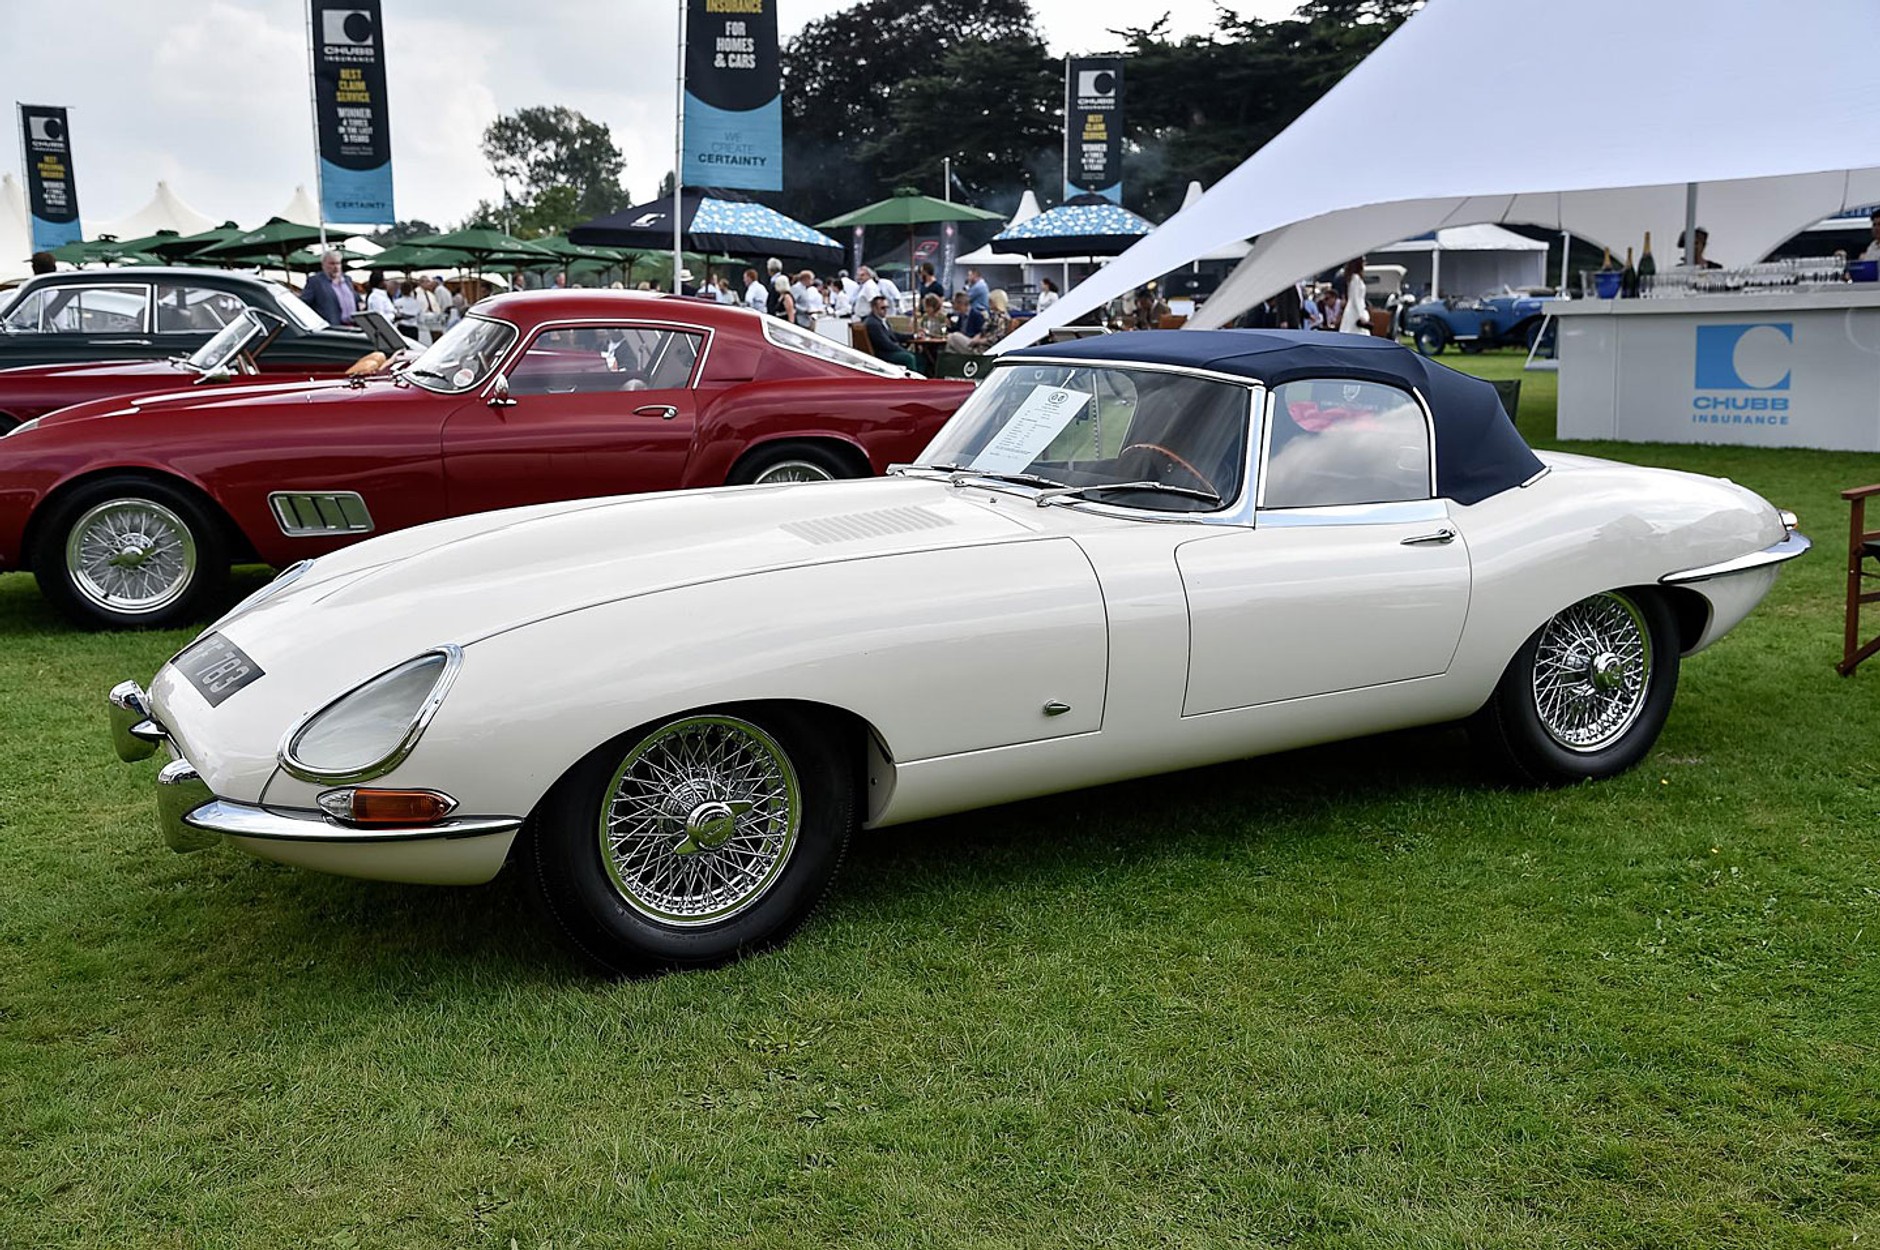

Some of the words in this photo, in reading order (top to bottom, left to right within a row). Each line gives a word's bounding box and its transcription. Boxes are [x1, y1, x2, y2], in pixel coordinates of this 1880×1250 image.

[725, 21, 746, 36] FOR
[323, 46, 375, 56] CHUBB
[716, 37, 755, 52] HOMES
[714, 53, 727, 68] &
[728, 53, 756, 69] CARS
[711, 142, 756, 155] CREATE
[698, 153, 768, 167] CERTAINTY
[1693, 396, 1789, 411] CHUBB
[1692, 414, 1789, 425] INSURANCE
[195, 651, 250, 693] 783
